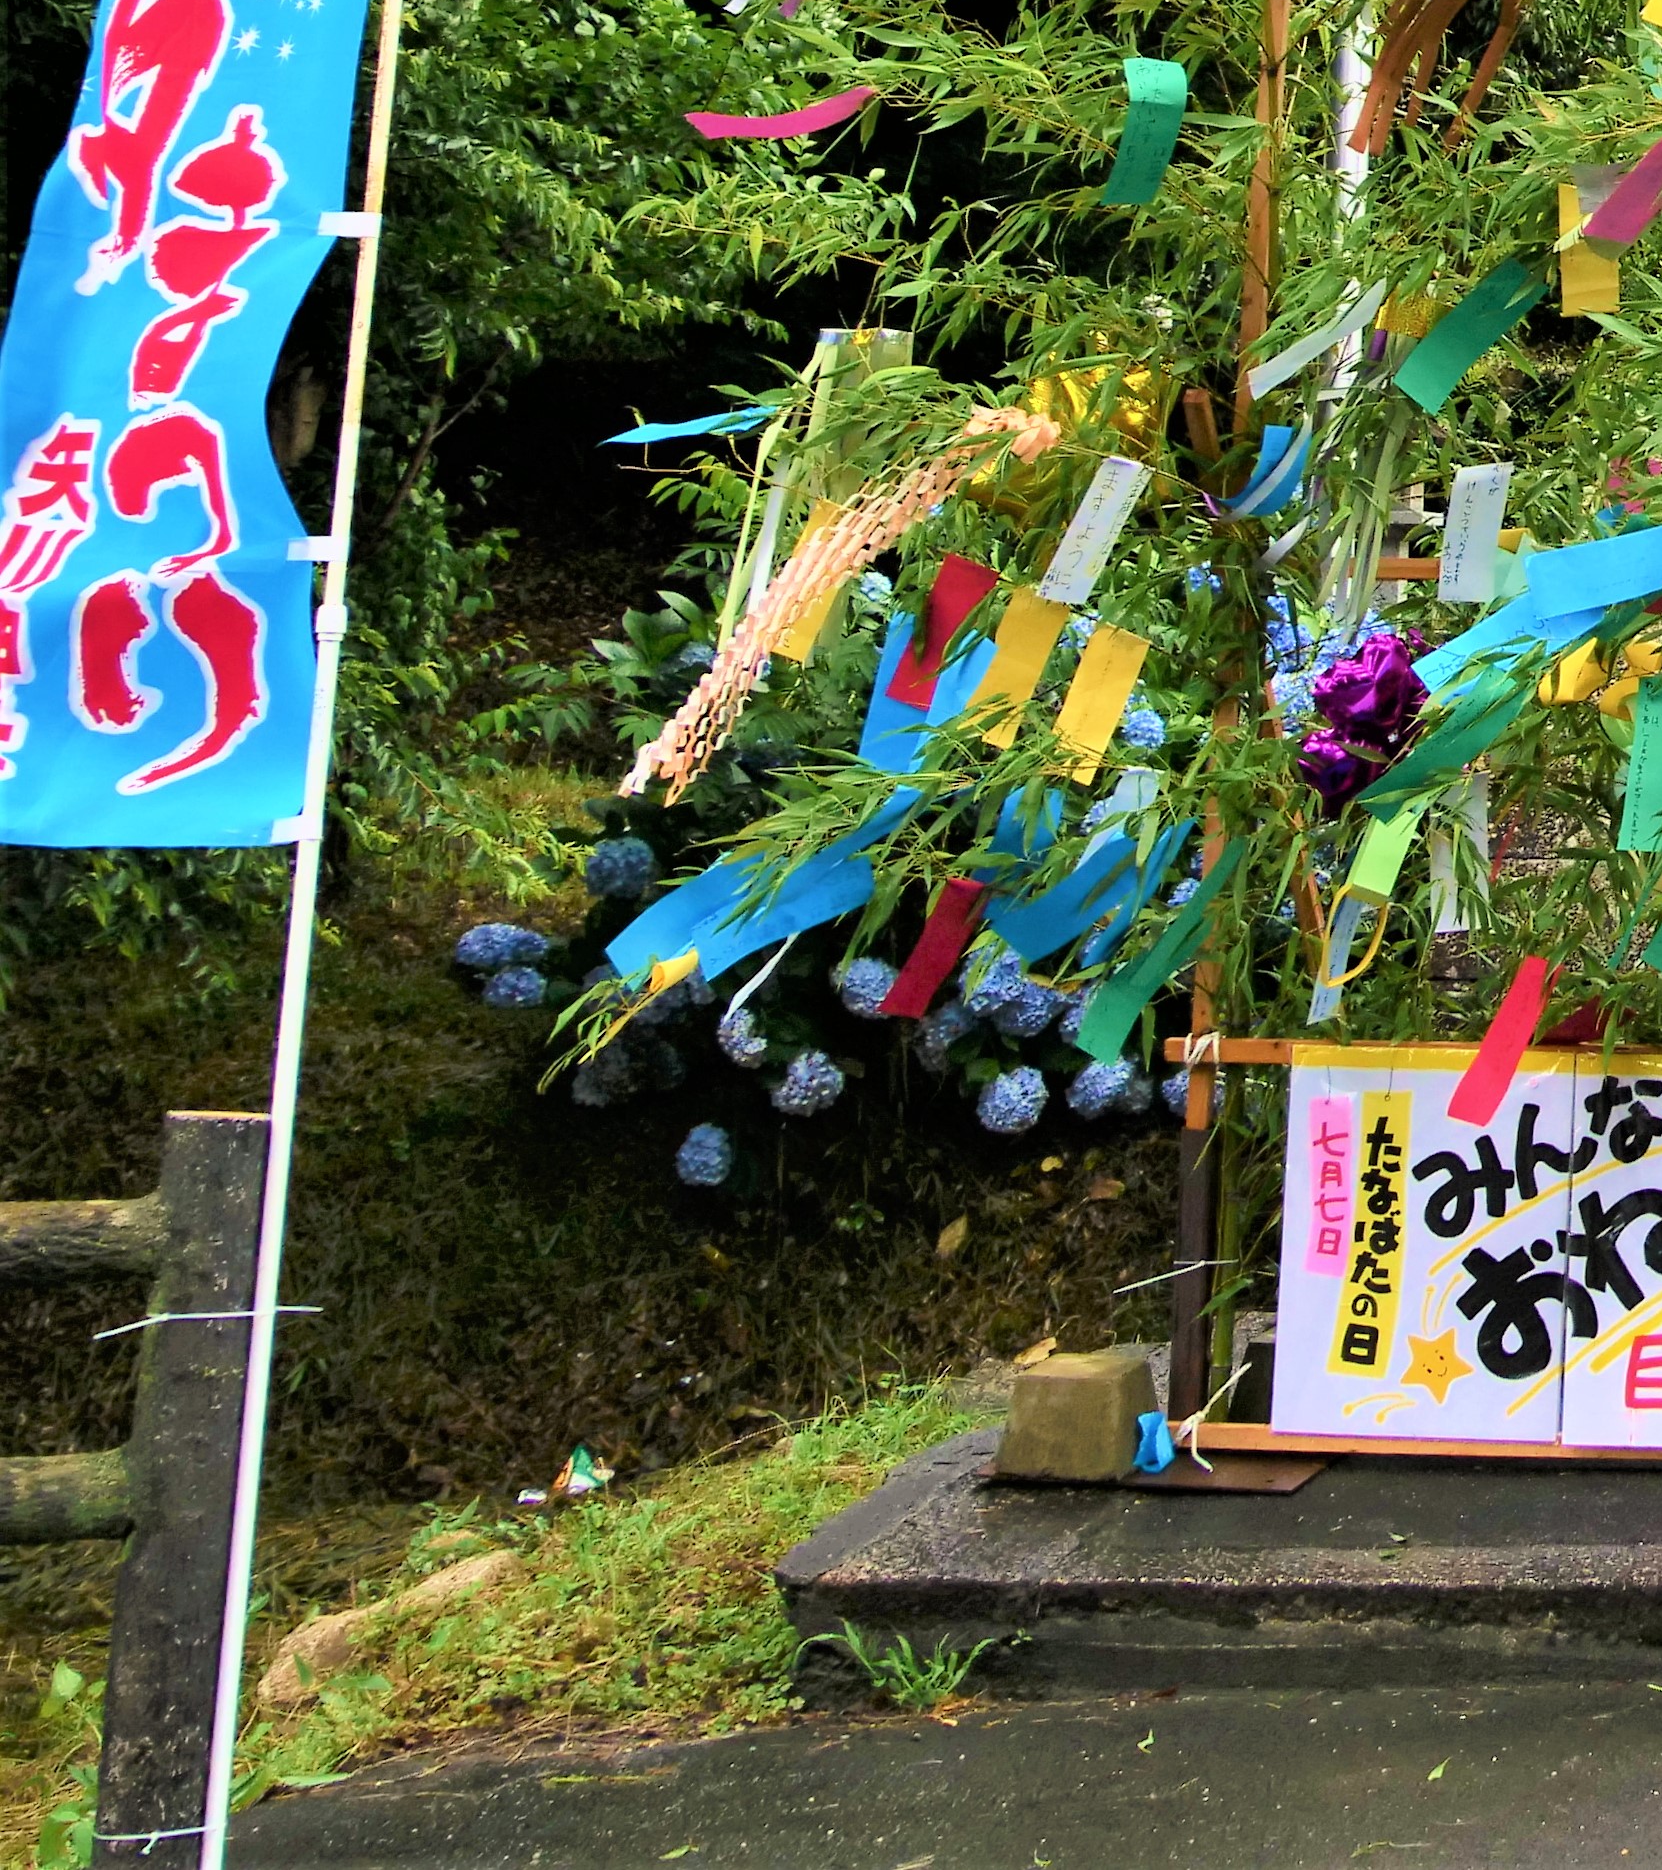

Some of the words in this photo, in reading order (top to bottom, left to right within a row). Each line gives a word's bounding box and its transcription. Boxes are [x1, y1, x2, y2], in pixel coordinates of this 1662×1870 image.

[0, 423, 96, 775] 矢川
[1311, 1120, 1348, 1257] 七月七日
[1341, 1116, 1404, 1366] たなばたの日
